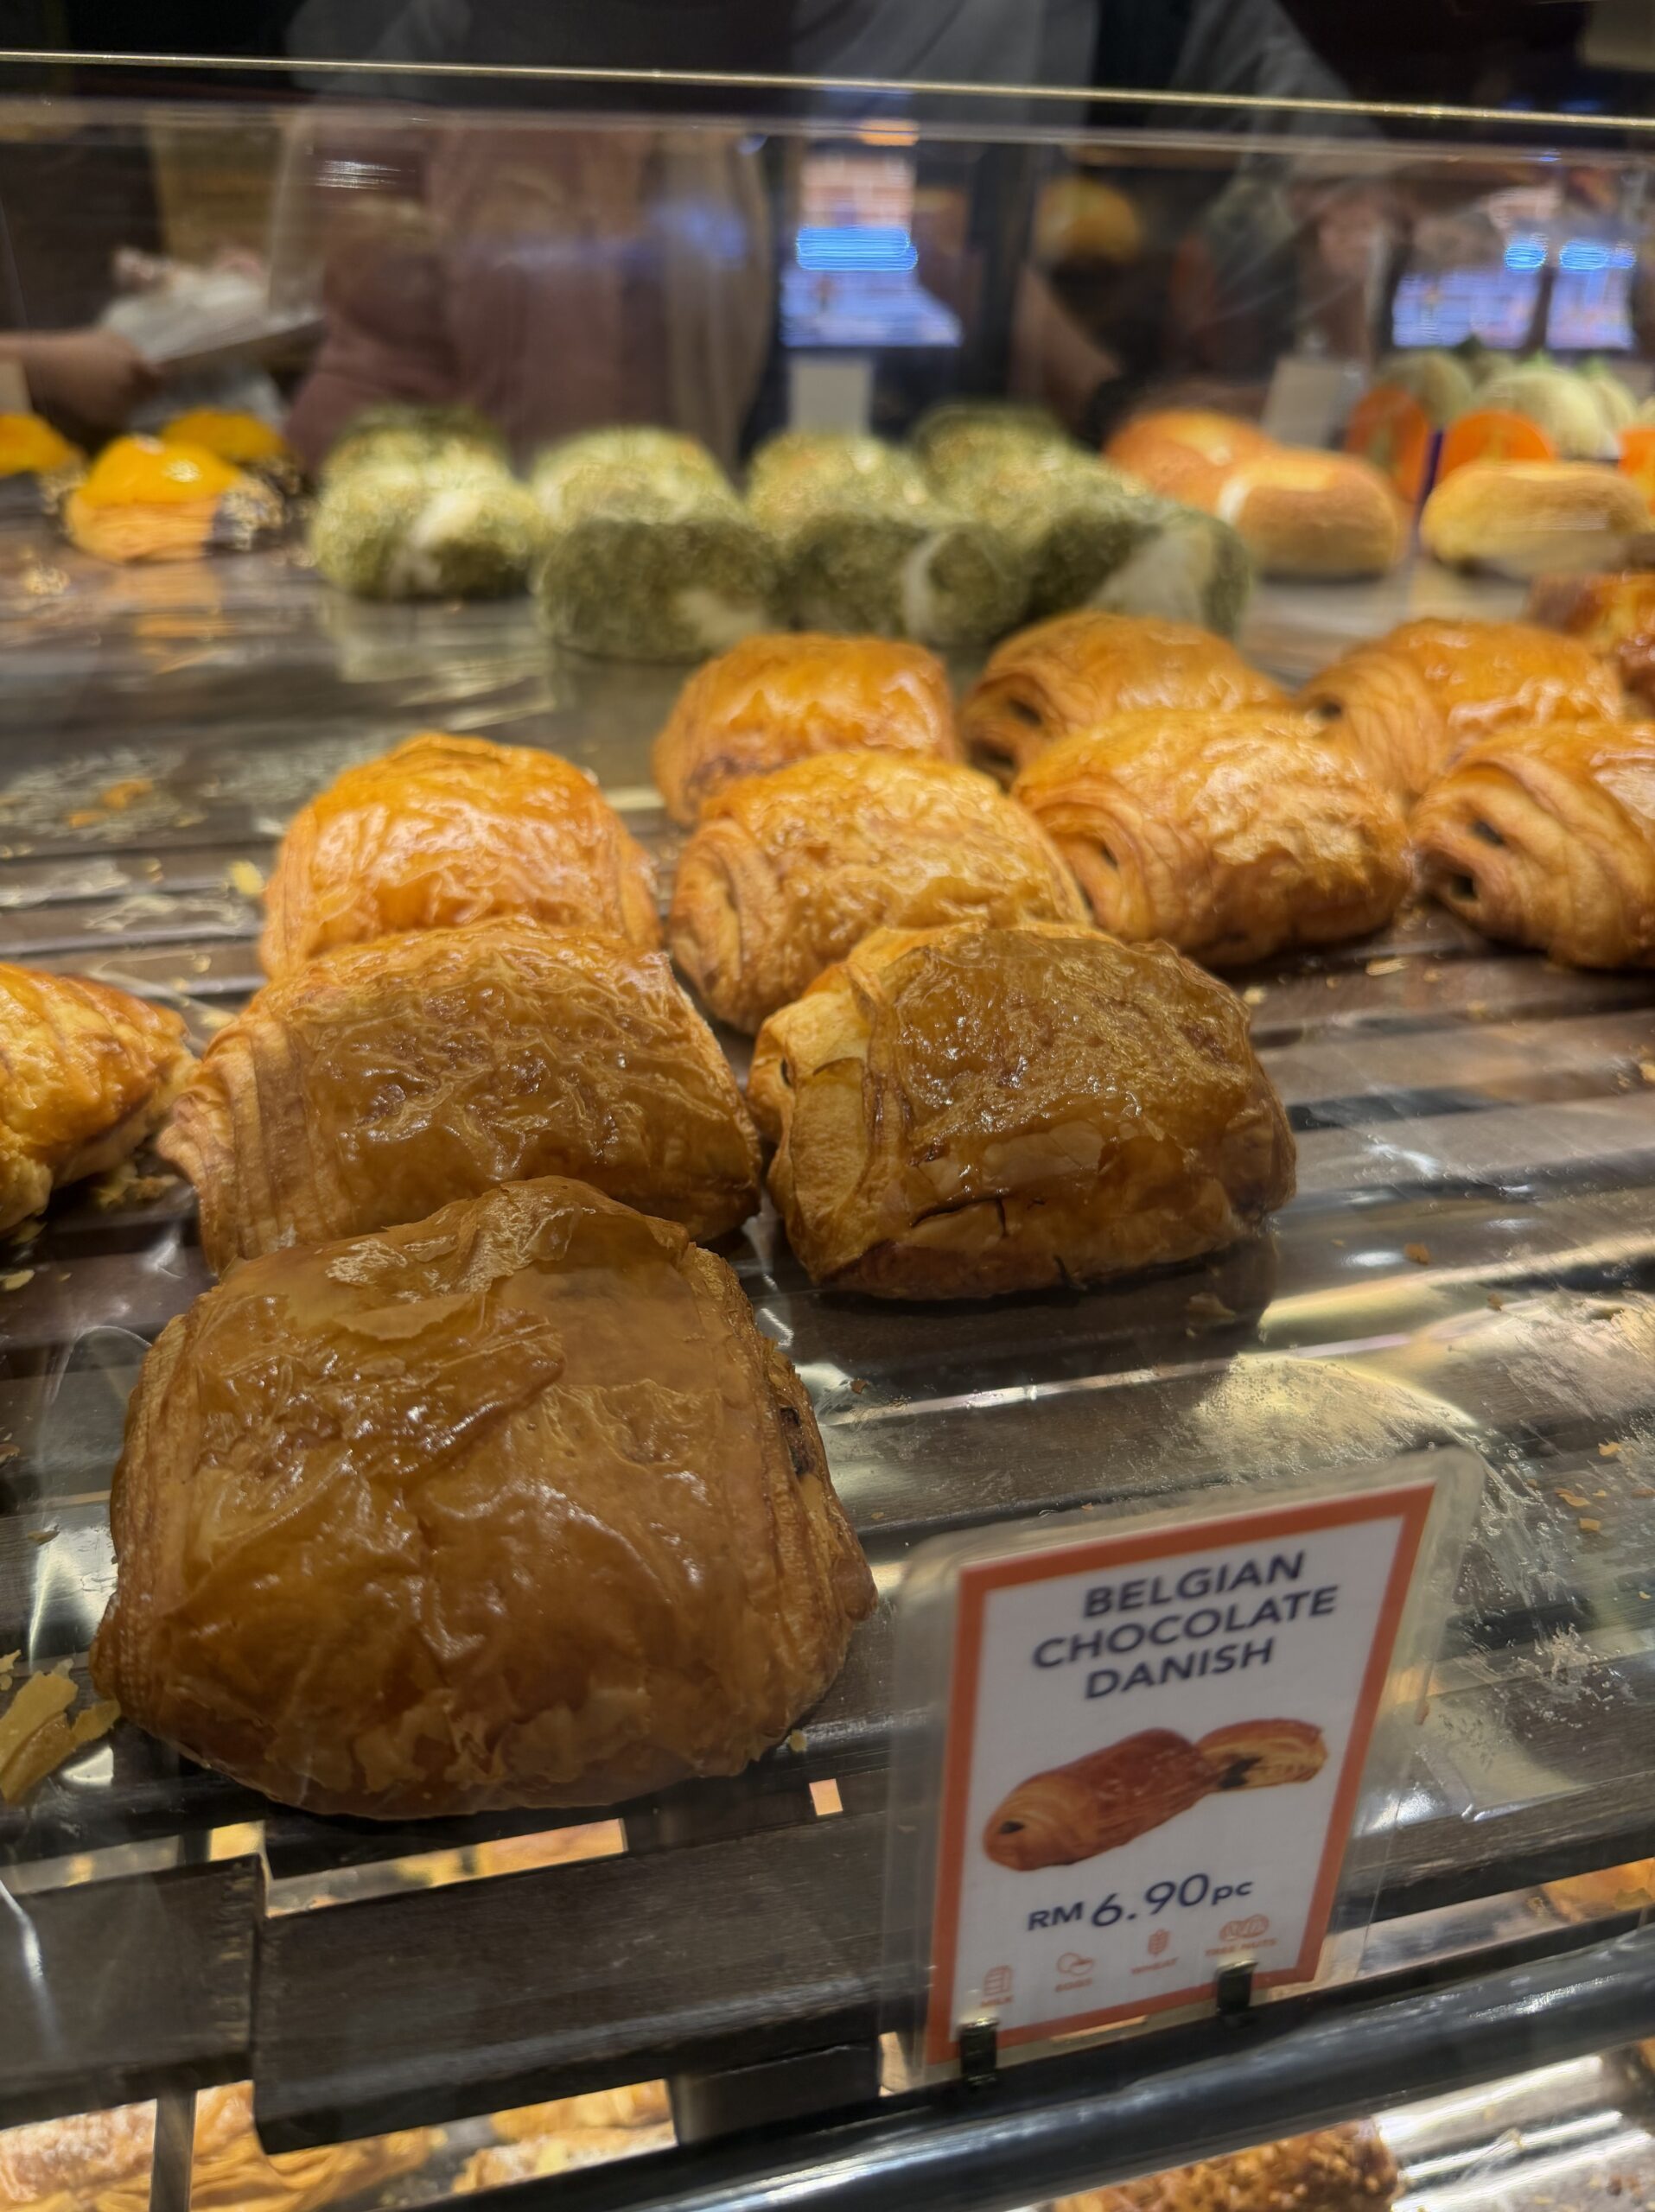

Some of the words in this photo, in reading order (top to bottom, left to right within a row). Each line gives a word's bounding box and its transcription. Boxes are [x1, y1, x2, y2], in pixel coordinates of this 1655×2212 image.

[1083, 1550, 1306, 1618] BELGIAN
[1031, 1580, 1339, 1669] CHOCOLATE
[1085, 1637, 1275, 1700] DANISH
[1028, 1902, 1085, 1931] RM
